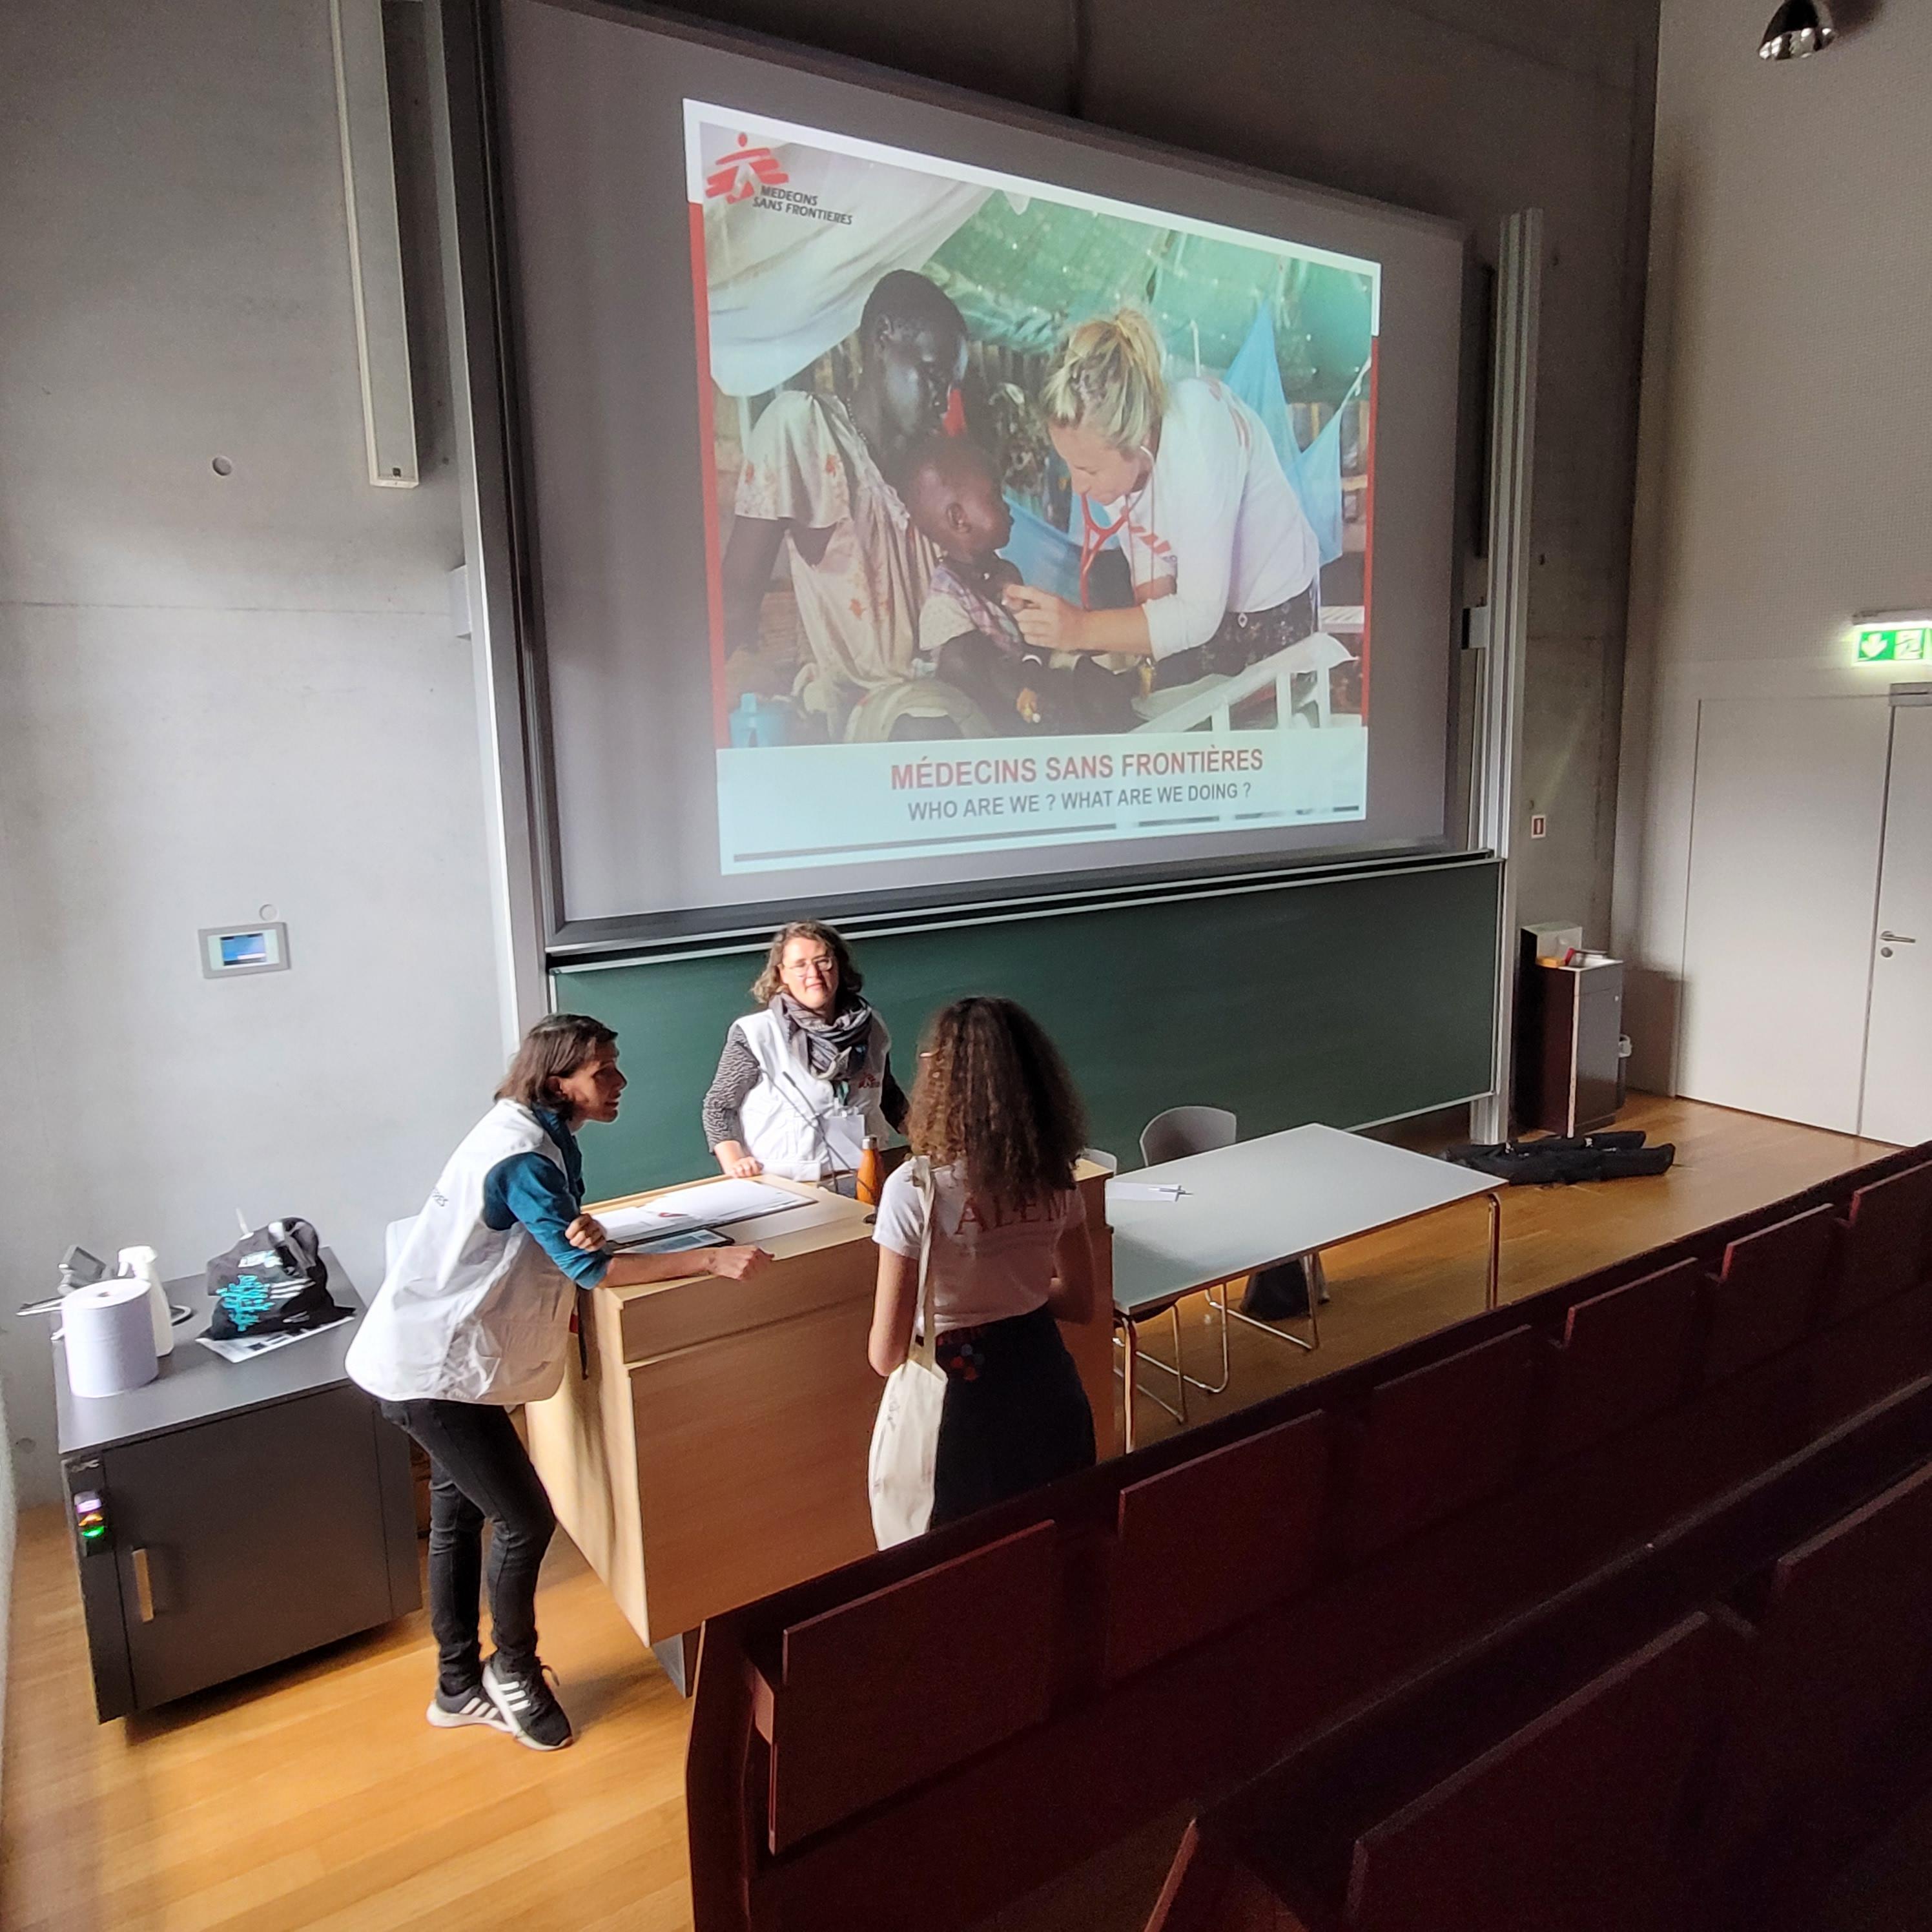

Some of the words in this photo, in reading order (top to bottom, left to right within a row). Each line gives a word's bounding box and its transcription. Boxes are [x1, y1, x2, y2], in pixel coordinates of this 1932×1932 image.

[752, 196, 783, 212] SANS
[785, 203, 853, 225] FRONTIERES
[760, 185, 819, 206] MEDECINS
[891, 755, 1037, 790] MÉDECINS
[1045, 754, 1113, 782] SANS
[1122, 745, 1263, 777] FRONTIÈRES
[908, 800, 958, 821] WHO
[963, 797, 1004, 817] ARE
[1009, 794, 1040, 814] WE
[1045, 794, 1056, 811] ?
[1061, 790, 1114, 810] WHAT
[1117, 788, 1152, 807] ARE
[1156, 786, 1183, 803] WE
[1188, 783, 1238, 801] DOING
[1242, 782, 1251, 799] ?
